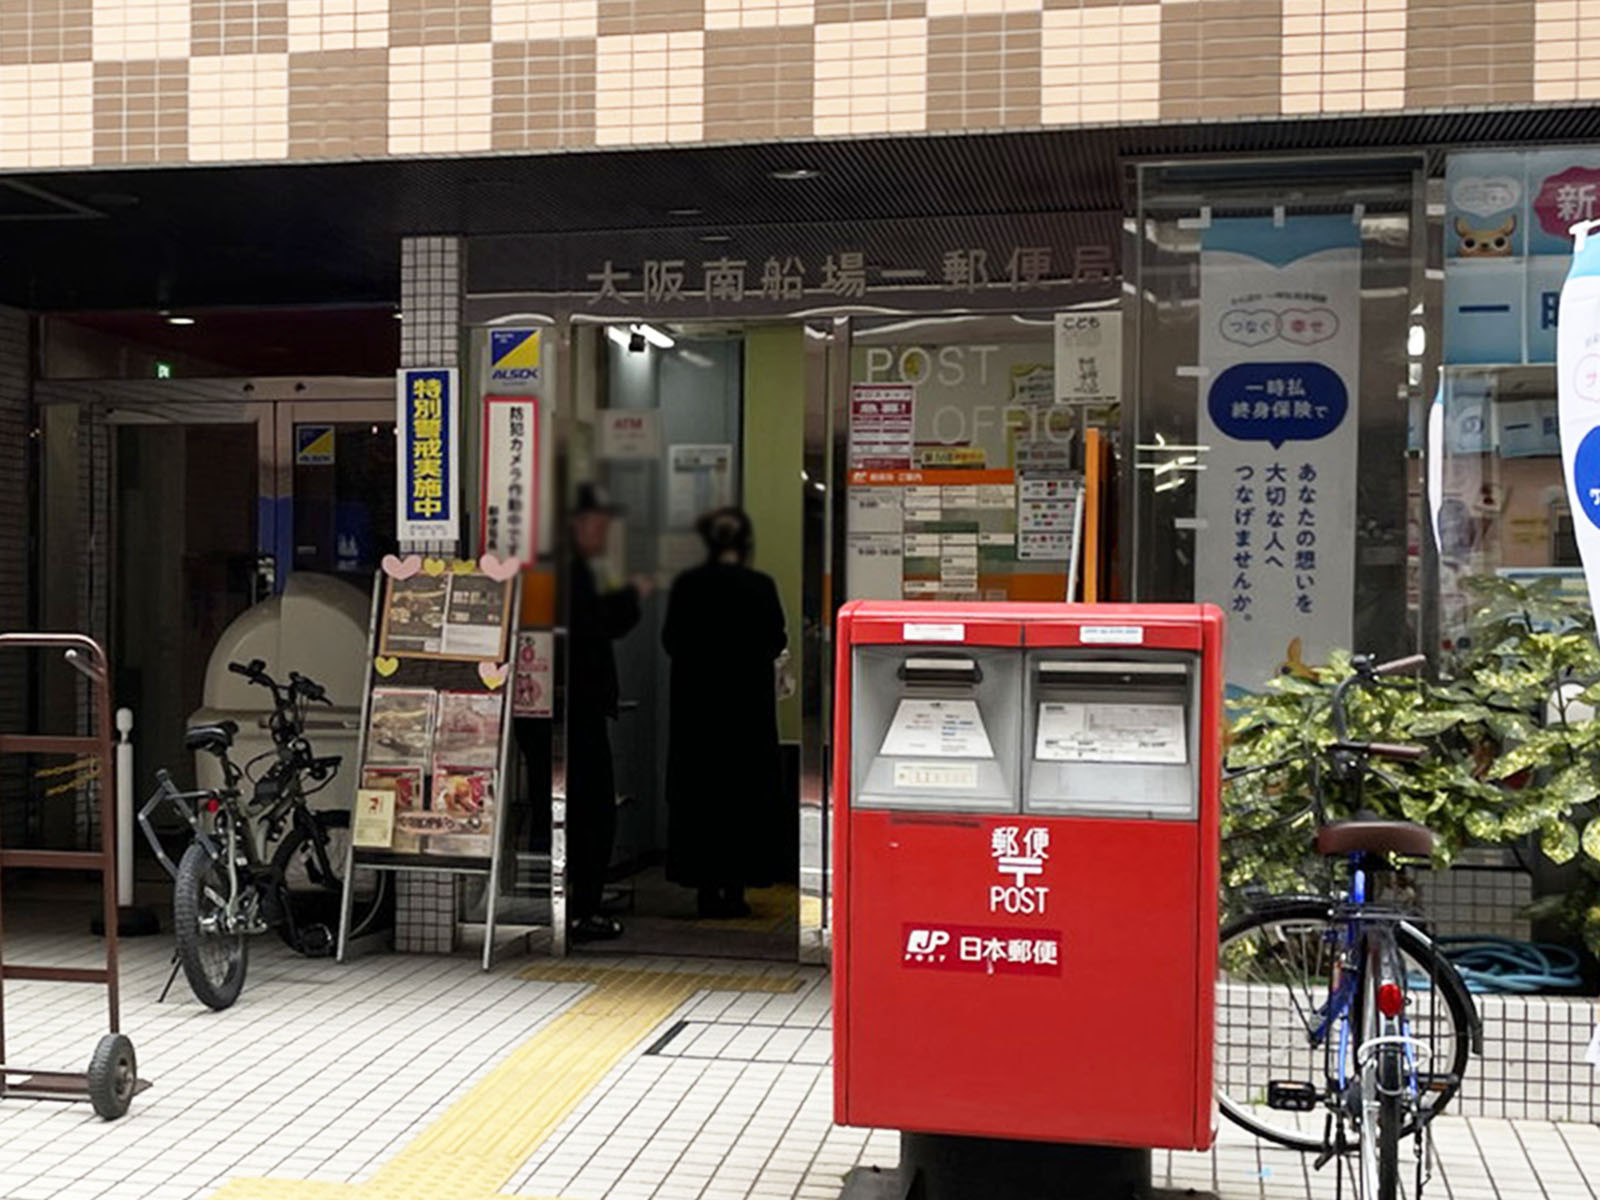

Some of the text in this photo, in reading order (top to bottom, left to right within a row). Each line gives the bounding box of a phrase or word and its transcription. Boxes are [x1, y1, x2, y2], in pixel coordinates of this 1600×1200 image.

[1556, 185, 1597, 221] 新
[586, 246, 1115, 304] 大阪南船場一郵便局
[1062, 316, 1100, 330] こども
[1230, 321, 1271, 334] つなぐ
[491, 369, 538, 380] ALSOK
[866, 346, 999, 386] POST
[1245, 379, 1306, 397] 一時払
[614, 417, 643, 429] ATM
[1231, 401, 1329, 419] 終身保険で
[413, 378, 442, 518] 特別警戒実施中
[1264, 462, 1287, 568] 大切な人へ
[1232, 465, 1256, 621] つなげませんか。
[1295, 462, 1318, 614] あなたの想いを
[991, 826, 1050, 860] 郵便
[989, 886, 1050, 914] POST
[959, 936, 1059, 965] 日本郵便
